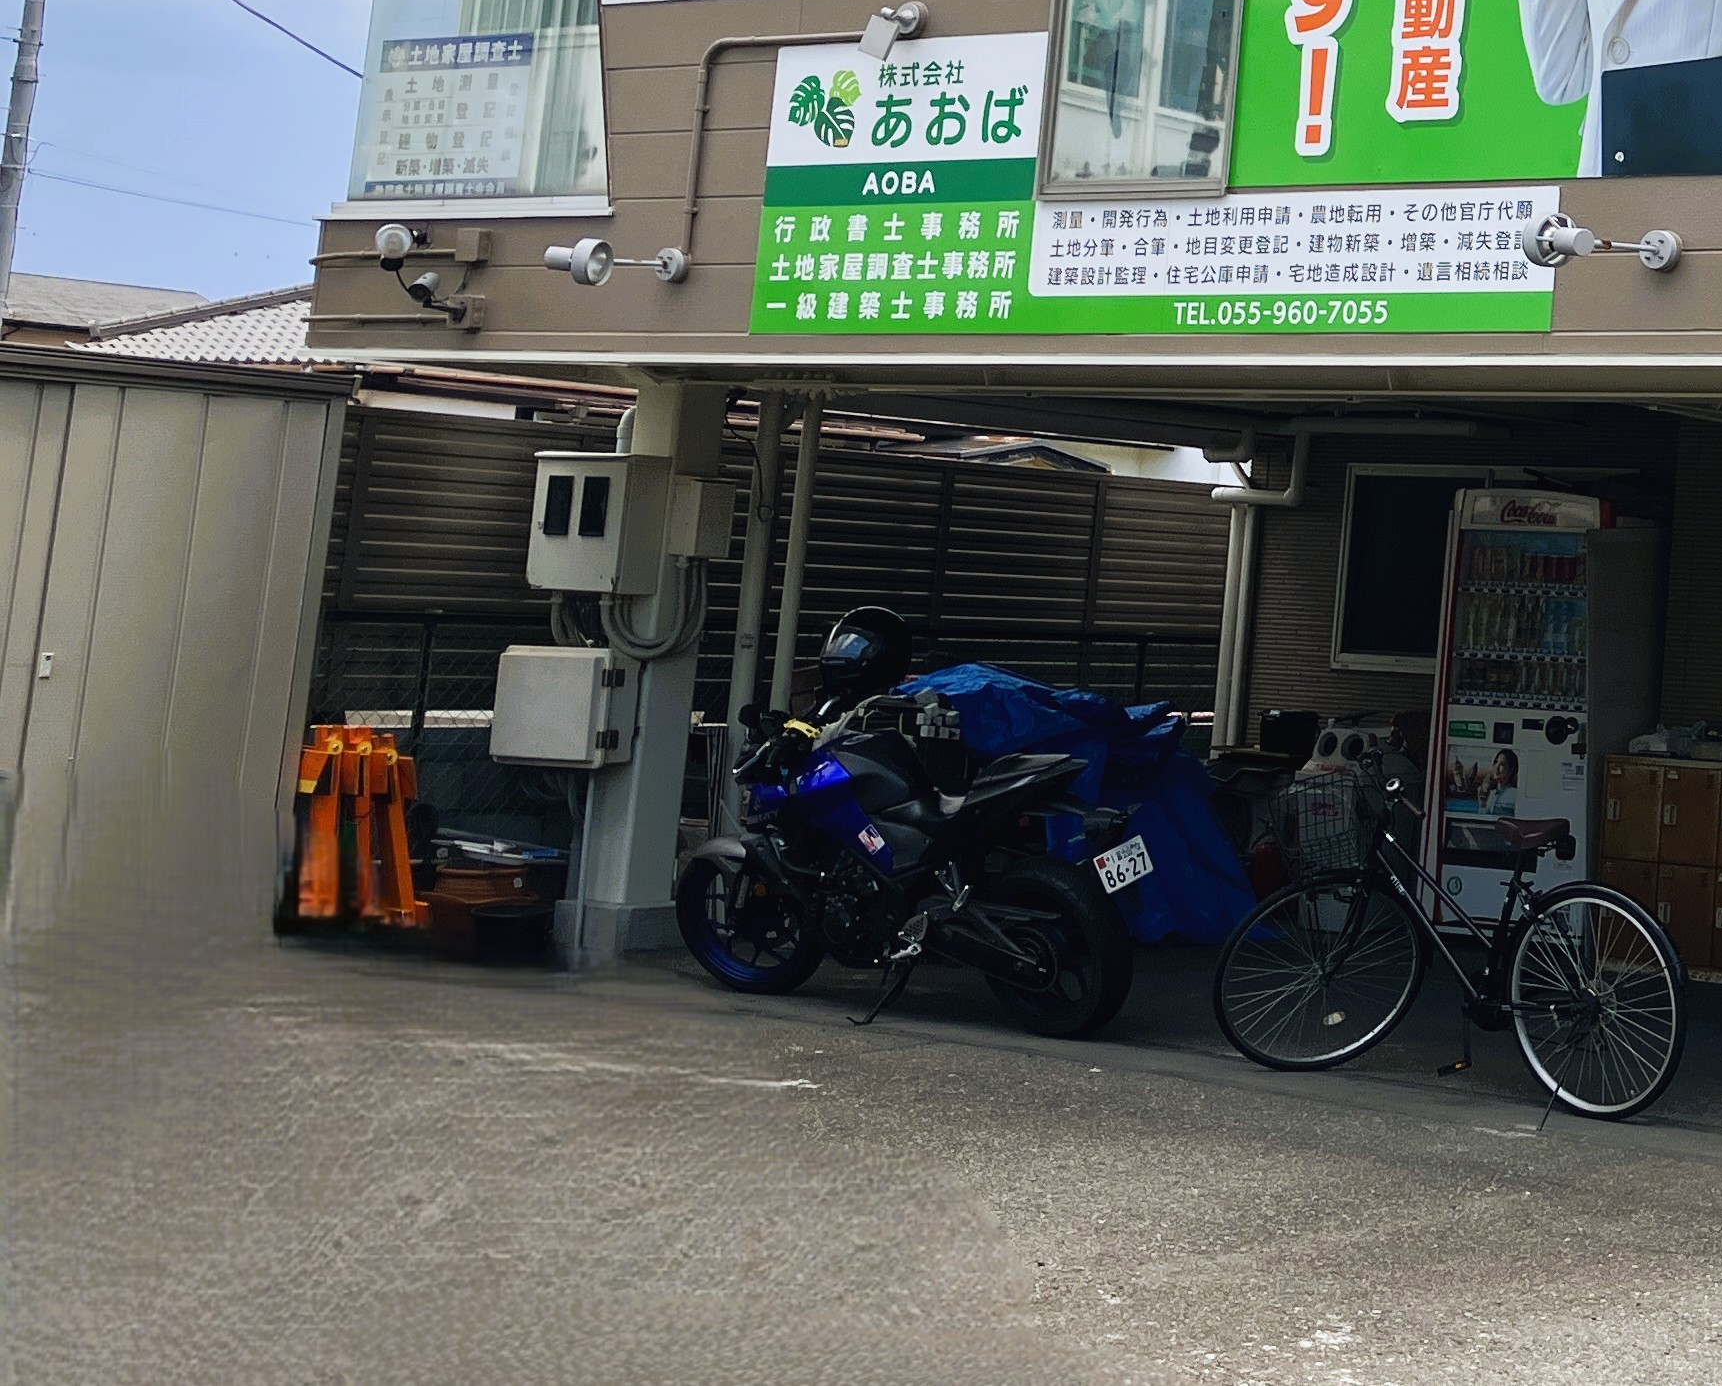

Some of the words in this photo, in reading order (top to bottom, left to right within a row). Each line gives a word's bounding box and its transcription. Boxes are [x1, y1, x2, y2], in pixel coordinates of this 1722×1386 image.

[878, 60, 965, 88] 株式会社
[871, 84, 1029, 148] あおば
[862, 170, 936, 195] AOBA
[774, 210, 1020, 244] 行政書士事務所
[769, 250, 1016, 282] 土地家屋調査士事務所
[766, 290, 1013, 320] 一級建築士事務所
[1174, 299, 1388, 325] TEL.055-960-7055
